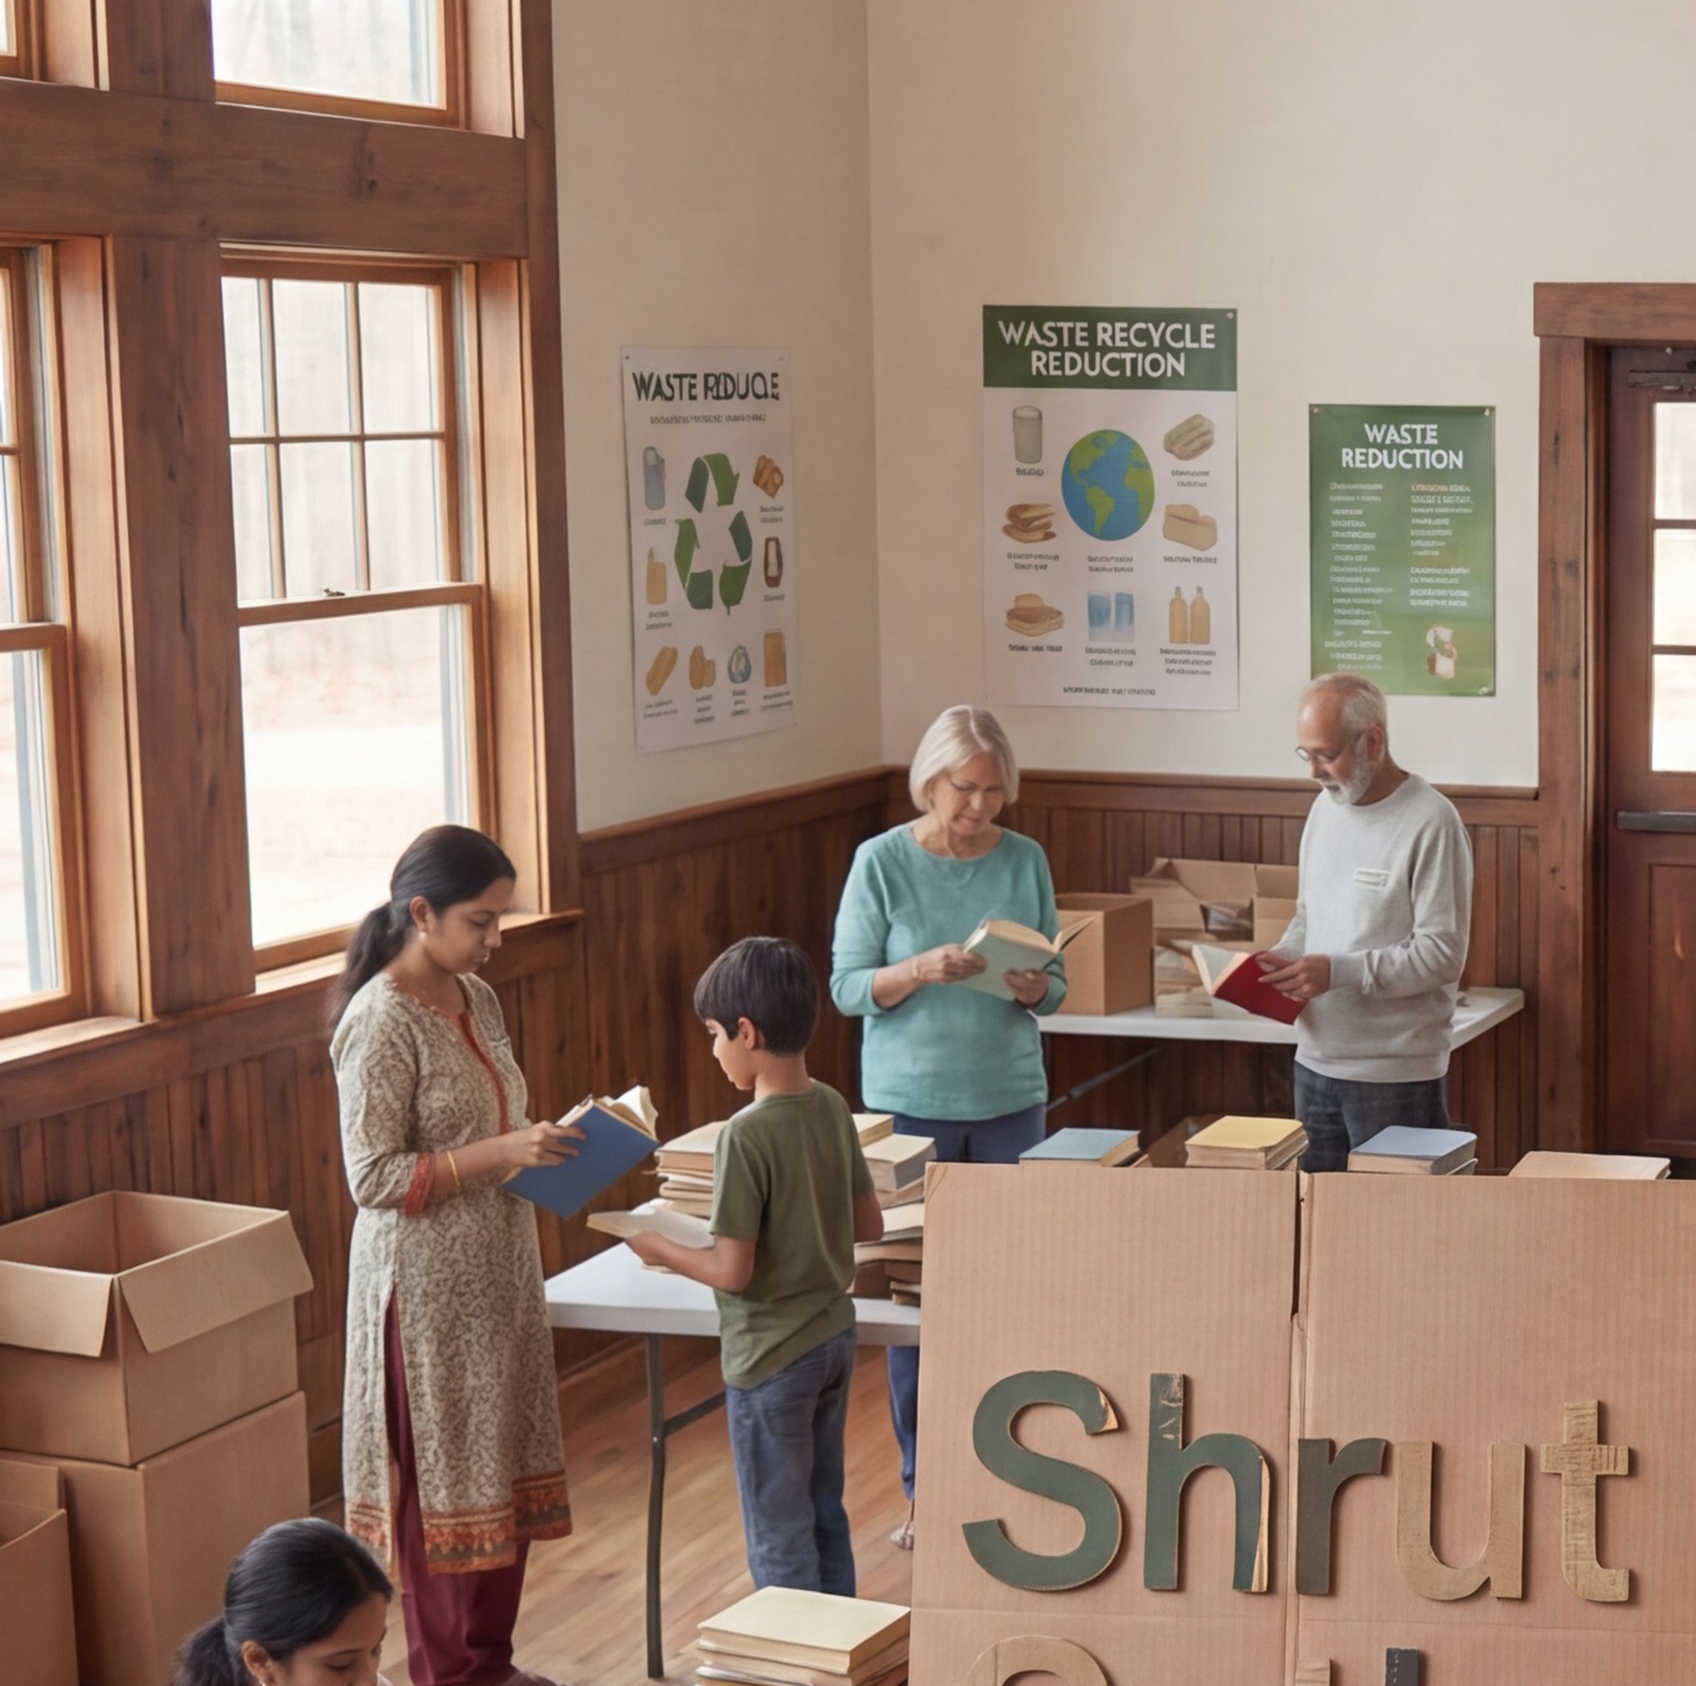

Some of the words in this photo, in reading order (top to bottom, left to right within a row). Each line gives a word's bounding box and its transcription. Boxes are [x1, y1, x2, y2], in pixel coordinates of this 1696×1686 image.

[998, 320, 1089, 347] WASTE
[1096, 322, 1215, 349] RECYCLE
[1031, 350, 1185, 378] REDUCTION
[632, 371, 697, 402] WASTE
[1364, 423, 1438, 445] WASTE
[1341, 448, 1463, 469] REDUCTION
[961, 1369, 1631, 1603] Shrut
